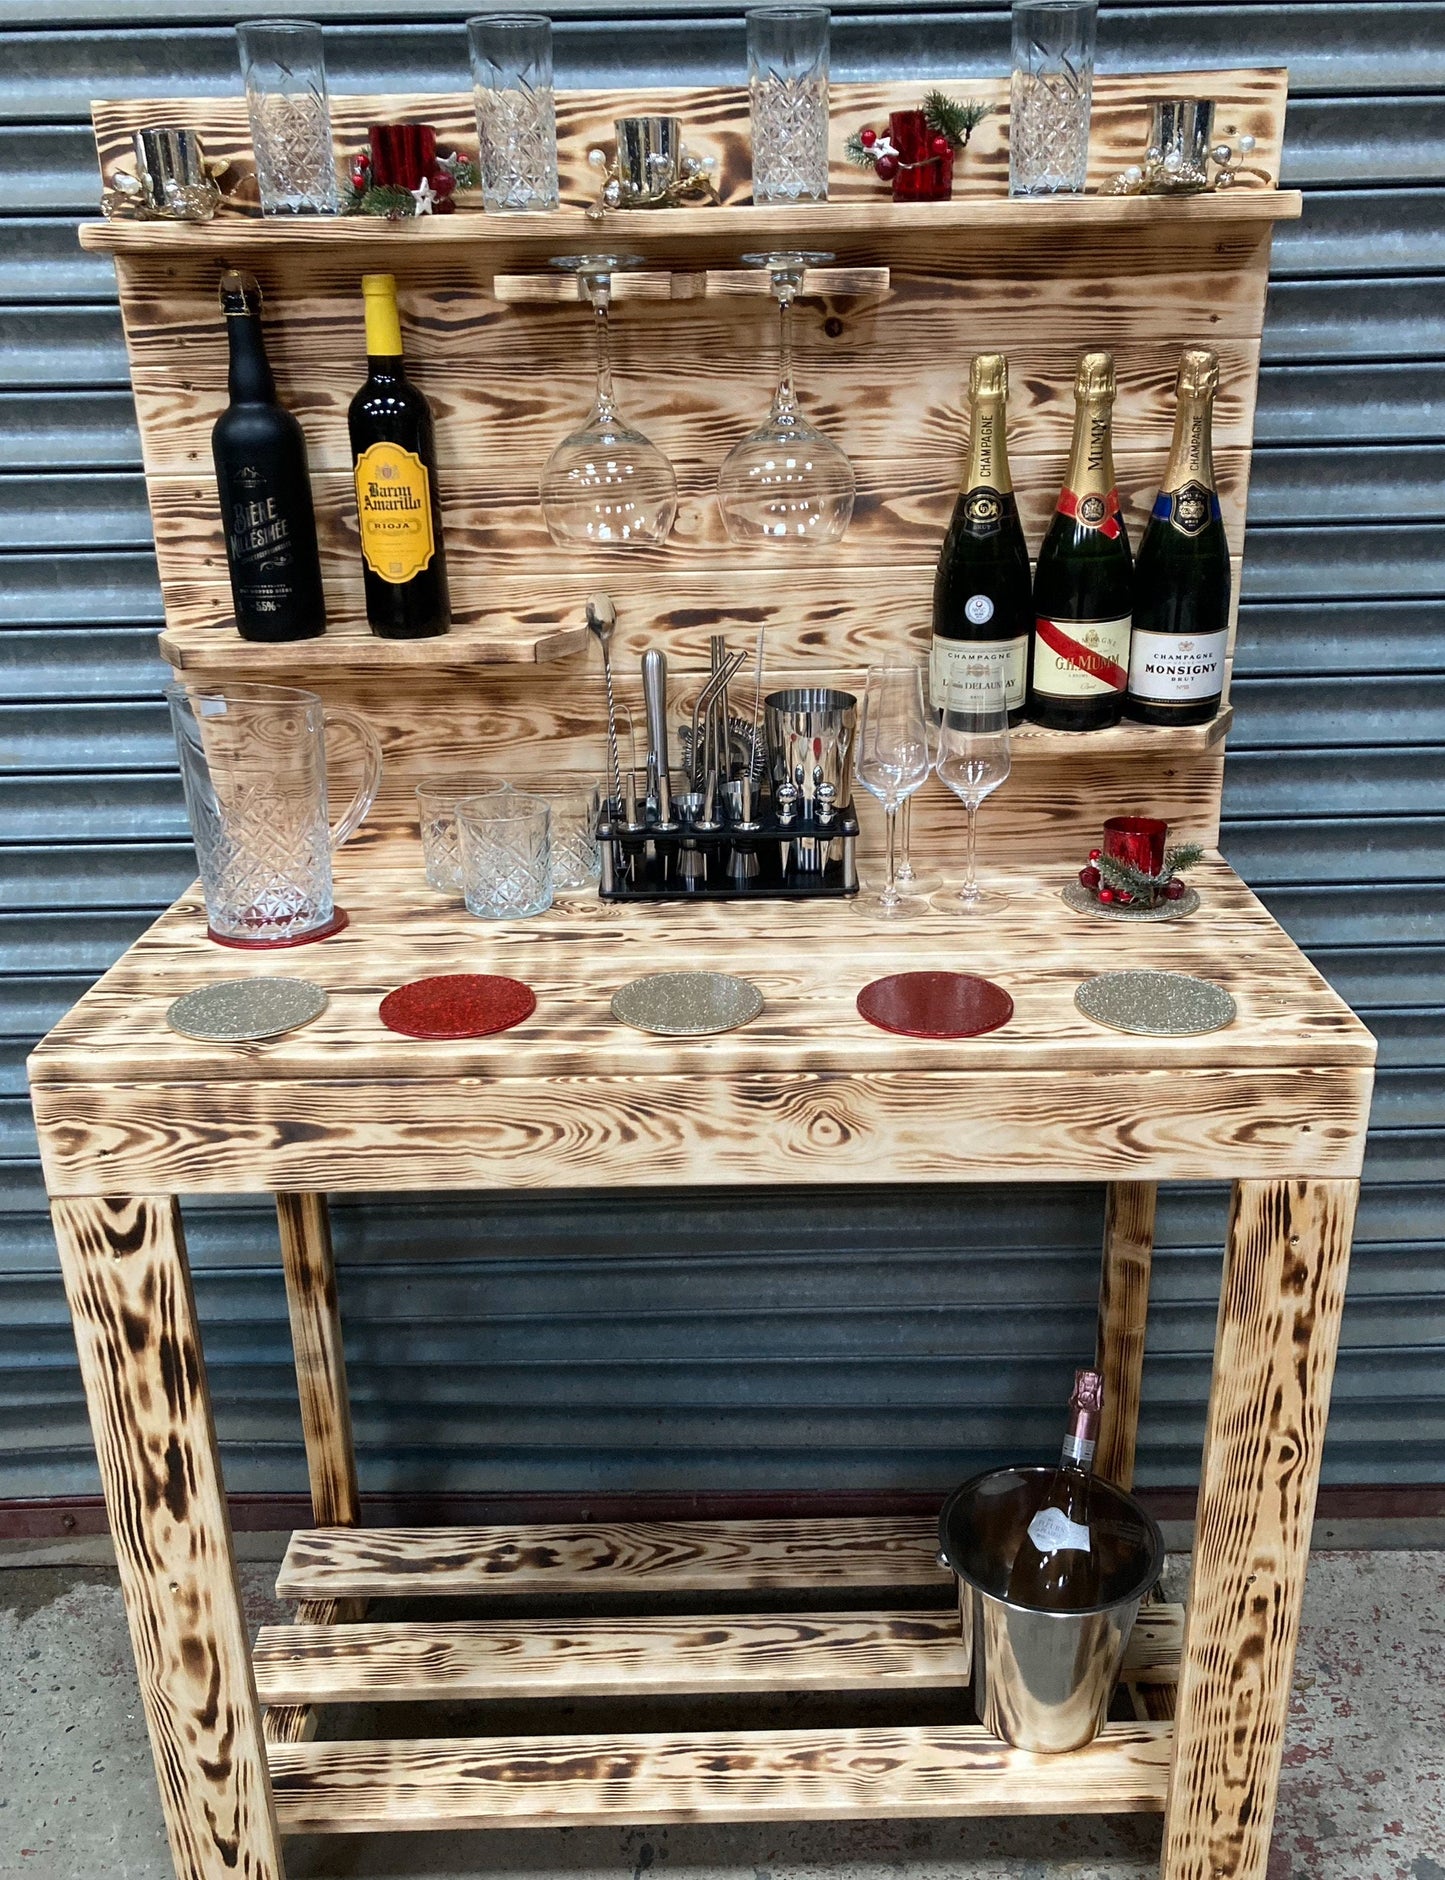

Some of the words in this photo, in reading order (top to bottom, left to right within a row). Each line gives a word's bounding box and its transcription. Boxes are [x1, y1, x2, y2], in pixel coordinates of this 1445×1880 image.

[979, 414, 994, 478] CHAMPAGNE
[1087, 419, 1105, 471] MUMM
[1189, 415, 1203, 471] CHAMPAGNE
[367, 482, 412, 498] Baron
[363, 495, 422, 511] Amarillo
[374, 521, 410, 530] RIOJA
[947, 652, 1011, 661] CHAMPAGNE
[1153, 652, 1214, 661] CHAMPAGNE
[1145, 661, 1218, 675] MONSIGNY
